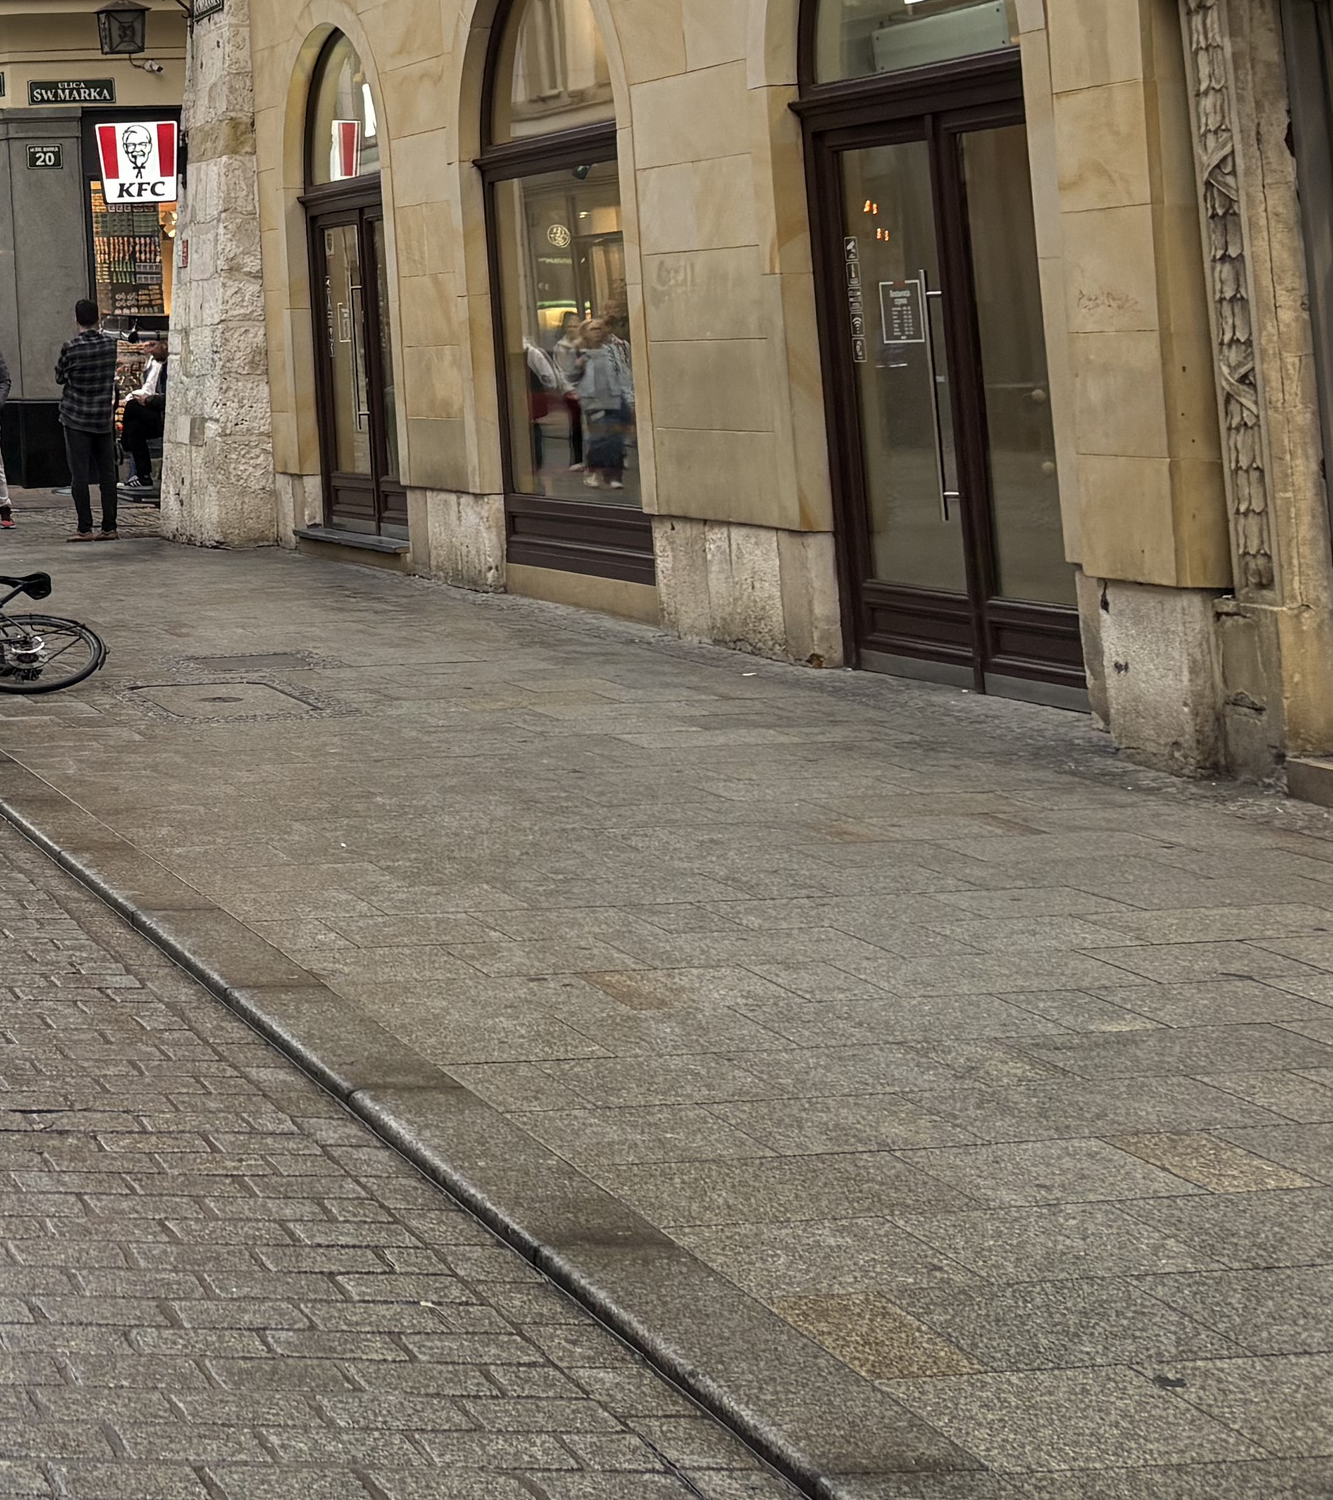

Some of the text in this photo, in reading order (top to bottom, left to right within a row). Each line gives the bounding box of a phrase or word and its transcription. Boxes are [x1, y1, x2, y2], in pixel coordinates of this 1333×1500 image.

[57, 81, 85, 89] ULICA
[56, 88, 111, 101] MARKA
[35, 152, 55, 166] 20
[117, 181, 166, 199] KFC
